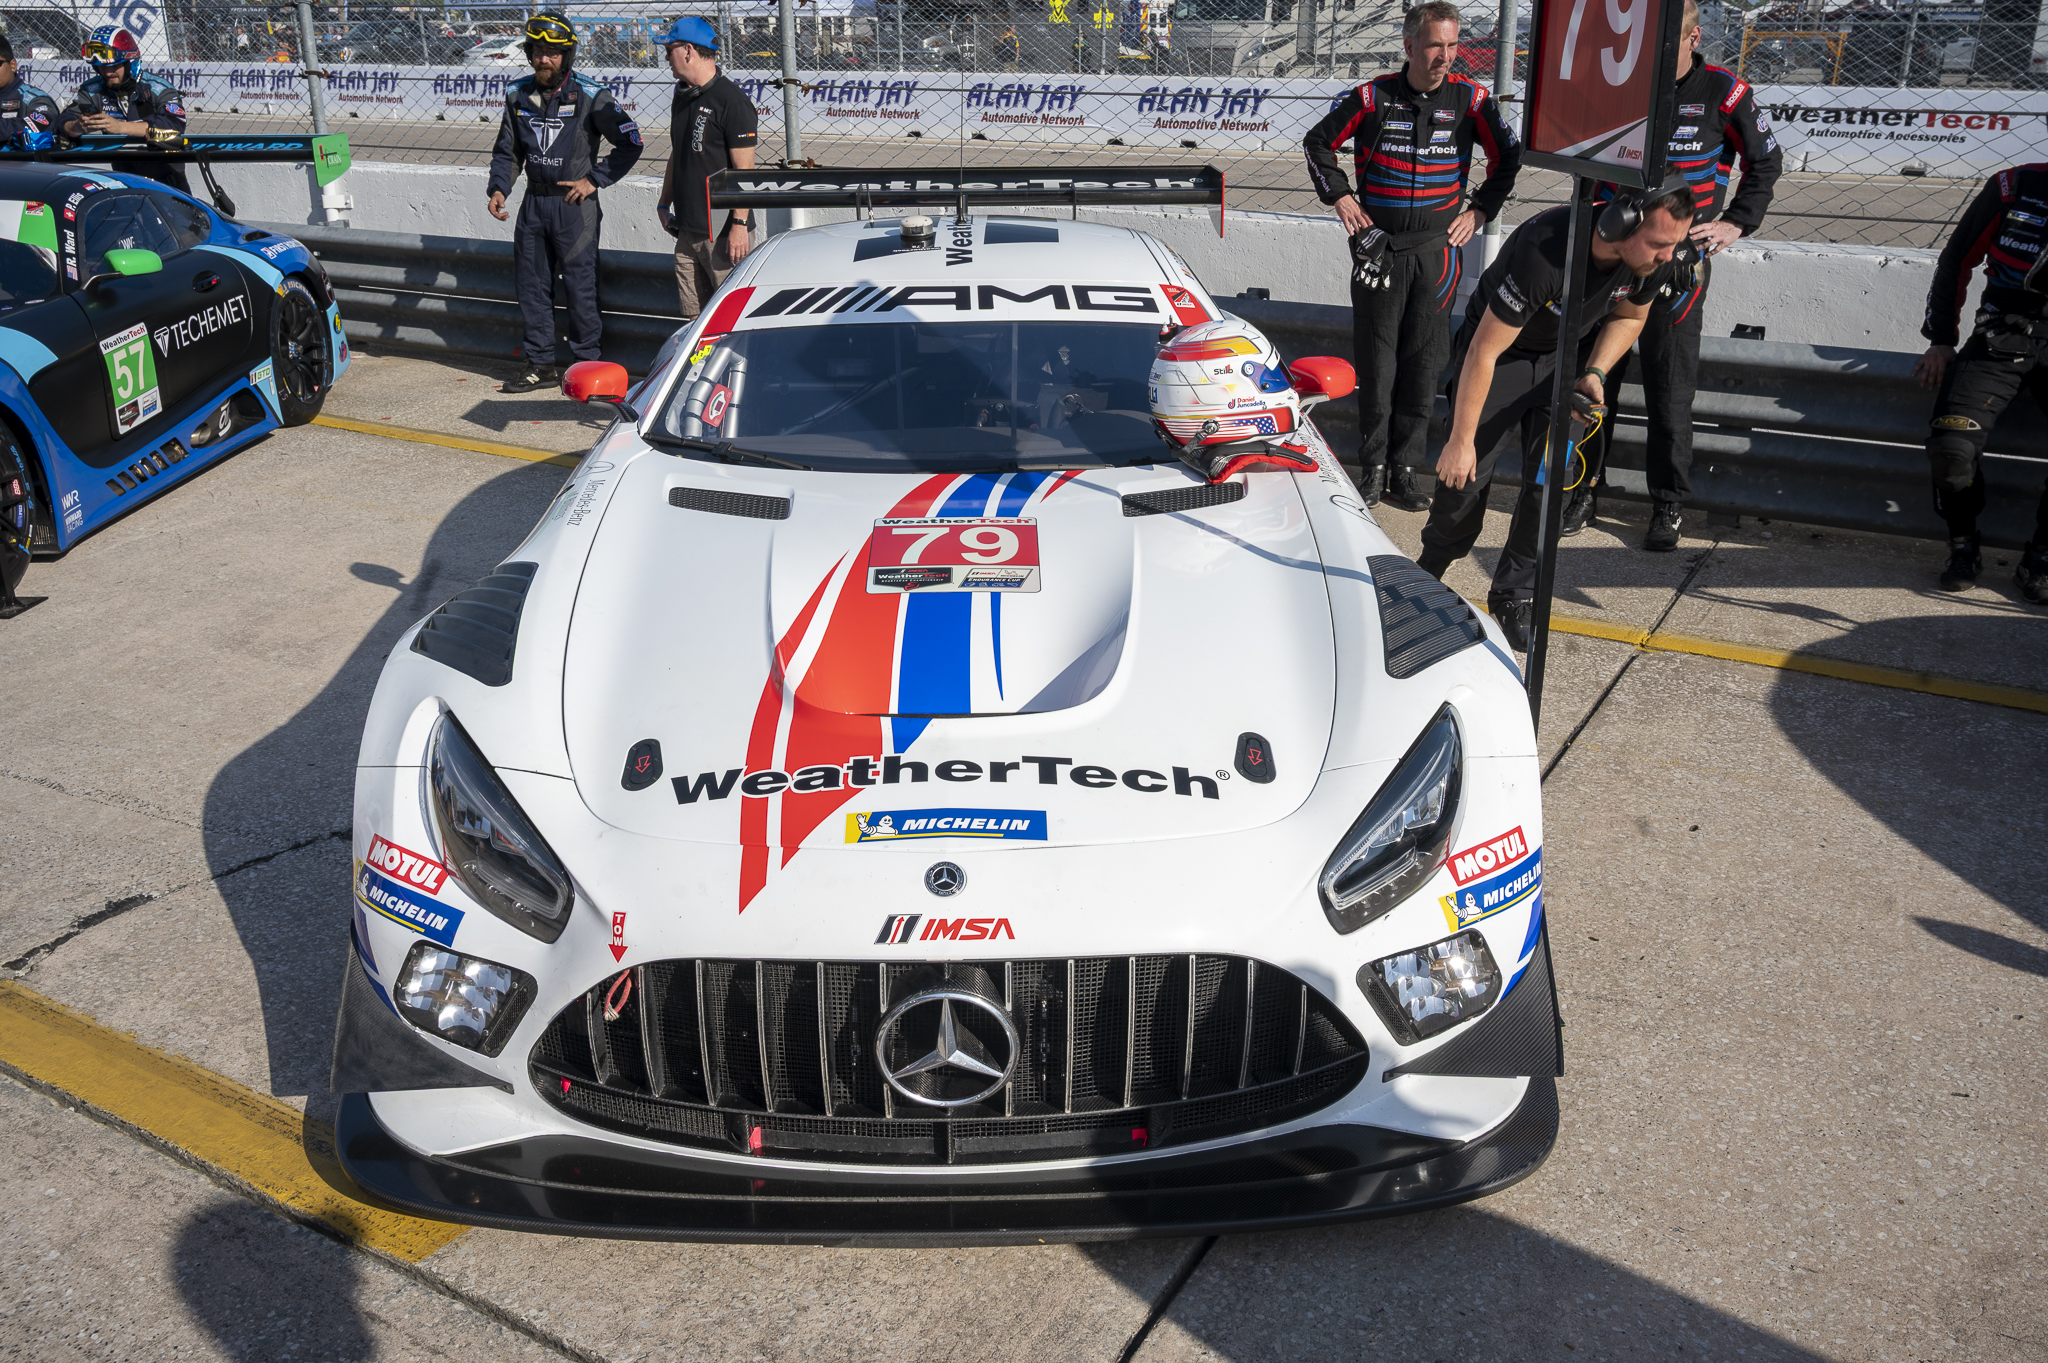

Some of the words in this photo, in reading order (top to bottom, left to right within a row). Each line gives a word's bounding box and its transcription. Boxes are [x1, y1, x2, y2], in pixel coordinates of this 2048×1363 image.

[178, 69, 201, 89] JAY
[230, 69, 266, 88] ALAN
[269, 70, 296, 90] JAY
[327, 70, 367, 91] ALAN
[370, 72, 400, 93] JAY
[433, 73, 476, 96] ALAN
[480, 74, 511, 98] JAY
[240, 91, 272, 101] Automotive
[275, 91, 300, 101] Network
[338, 93, 375, 104] Automotive
[376, 94, 404, 105] Network
[445, 97, 484, 107] Automotive
[812, 79, 872, 105] ALAN
[875, 80, 919, 108] JAY
[966, 82, 1032, 109] ALAN
[1035, 84, 1086, 113] JAY
[1138, 86, 1212, 115] ALAN
[1214, 87, 1271, 120] JAY
[826, 107, 878, 119] Automotive
[880, 108, 920, 120] Network
[981, 111, 1038, 125] Automotive
[1041, 112, 1085, 126] Network
[1154, 117, 1216, 130] Automotive
[1219, 119, 1270, 132] Network
[1806, 127, 1882, 140] Automotive
[1885, 130, 1967, 144] Accessories
[1382, 142, 1458, 155] WeatherTech
[1625, 149, 1642, 160] IMSA
[63, 229, 76, 255] Ward
[873, 285, 1160, 314] AMG
[171, 294, 248, 350] TECHEMET
[101, 325, 146, 351] WeatherTech
[112, 339, 146, 399] 57
[257, 367, 271, 380] GTD
[1213, 364, 1234, 376] Stilo
[1237, 396, 1255, 404] Daniel
[881, 518, 1032, 526] WeatherTech
[891, 526, 1020, 565] 79
[901, 816, 1030, 832] MICHELIN
[372, 840, 443, 891] MOTUL
[1457, 832, 1526, 883] MOTUL
[1483, 859, 1542, 909] MICHELIN
[369, 885, 449, 931] MICHELIN
[612, 913, 624, 947] TOW
[919, 917, 1016, 941] IMSA
